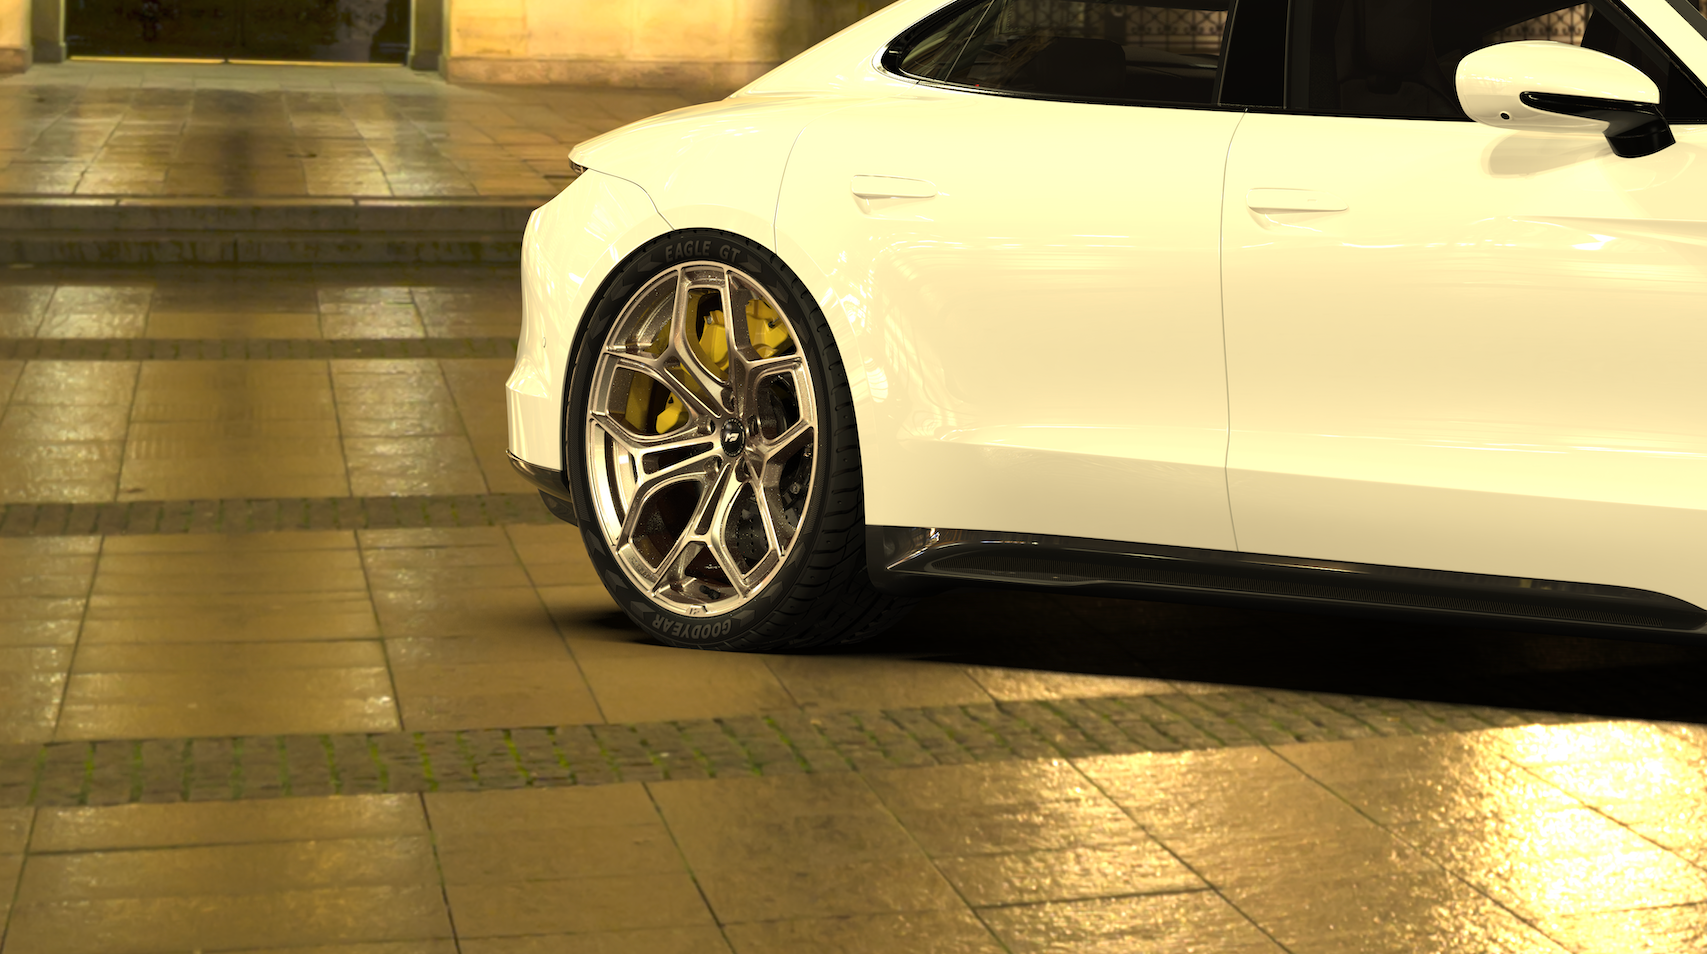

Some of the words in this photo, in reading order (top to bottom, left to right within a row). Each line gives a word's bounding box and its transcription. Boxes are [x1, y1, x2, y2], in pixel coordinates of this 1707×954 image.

[665, 239, 711, 263] EAGLE
[720, 244, 740, 263] GT
[652, 613, 732, 640] GOODYEAR
